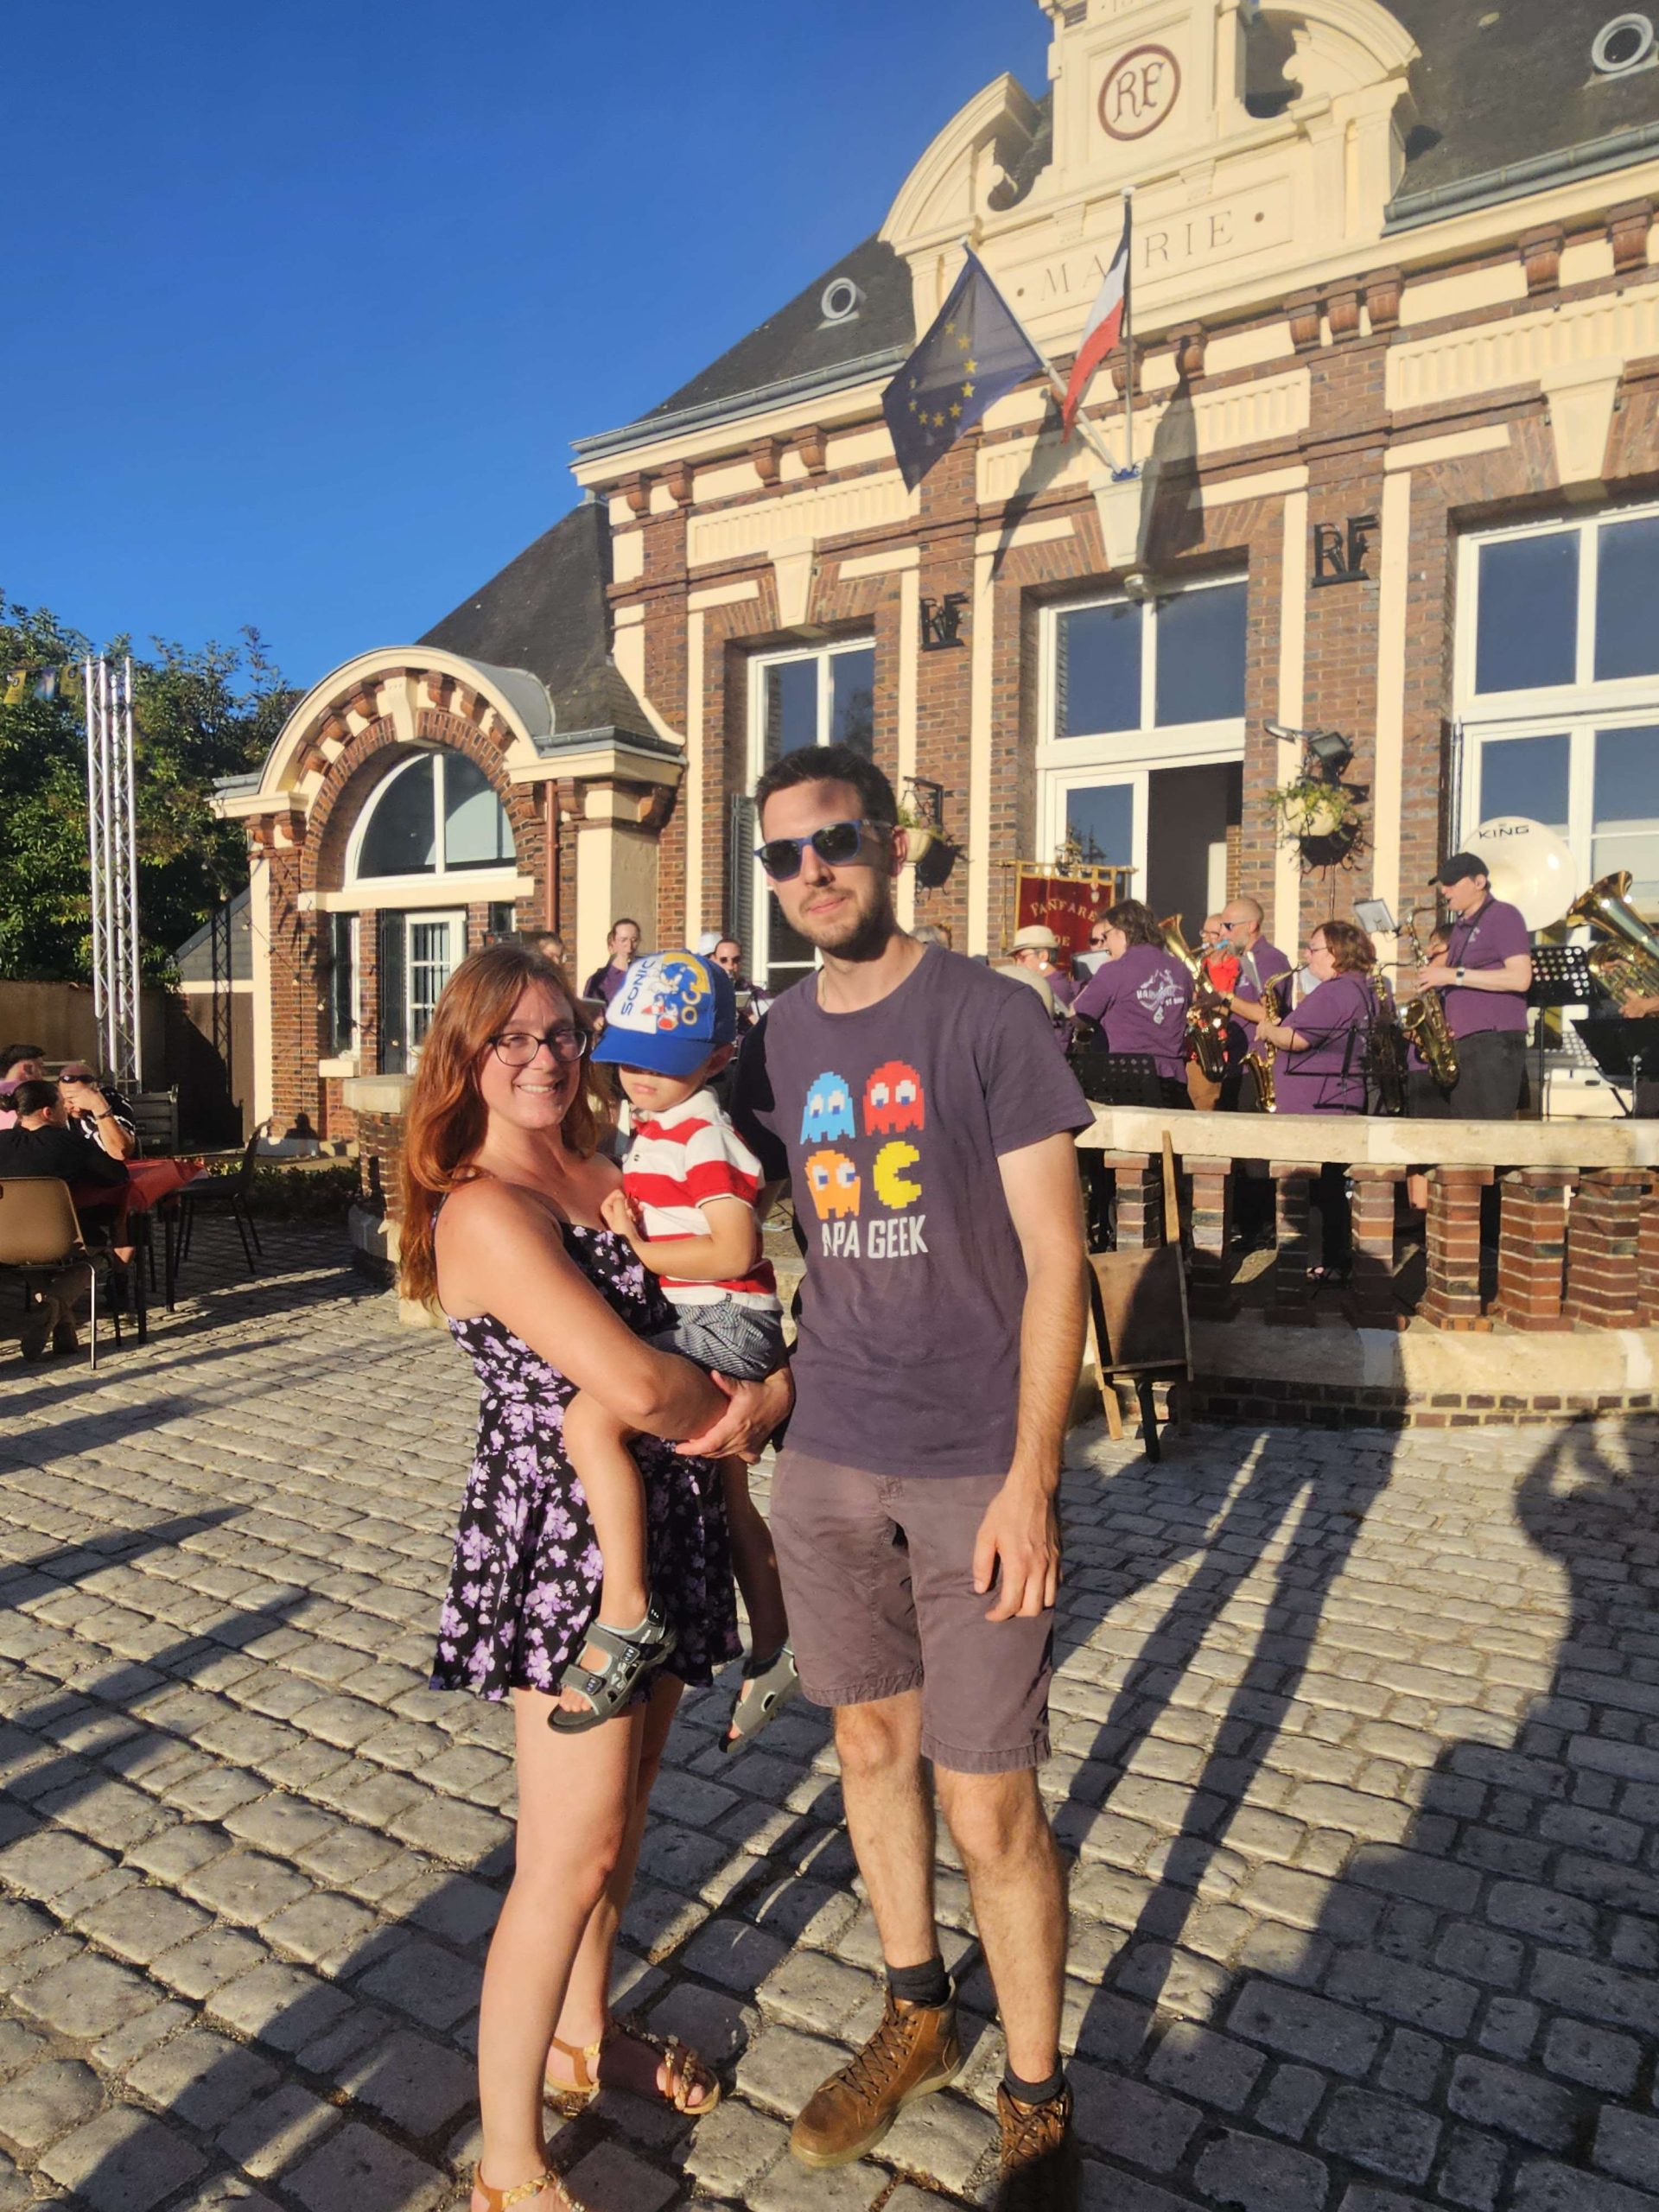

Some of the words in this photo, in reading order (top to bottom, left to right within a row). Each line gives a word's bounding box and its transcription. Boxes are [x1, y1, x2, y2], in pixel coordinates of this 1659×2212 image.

[1113, 60, 1166, 123] RF
[1040, 210, 1233, 302] MARIE
[1478, 824, 1529, 839] KING
[1030, 899, 1098, 922] FANFARE
[620, 960, 656, 1015] SONIC
[868, 1214, 929, 1259] GEEK
